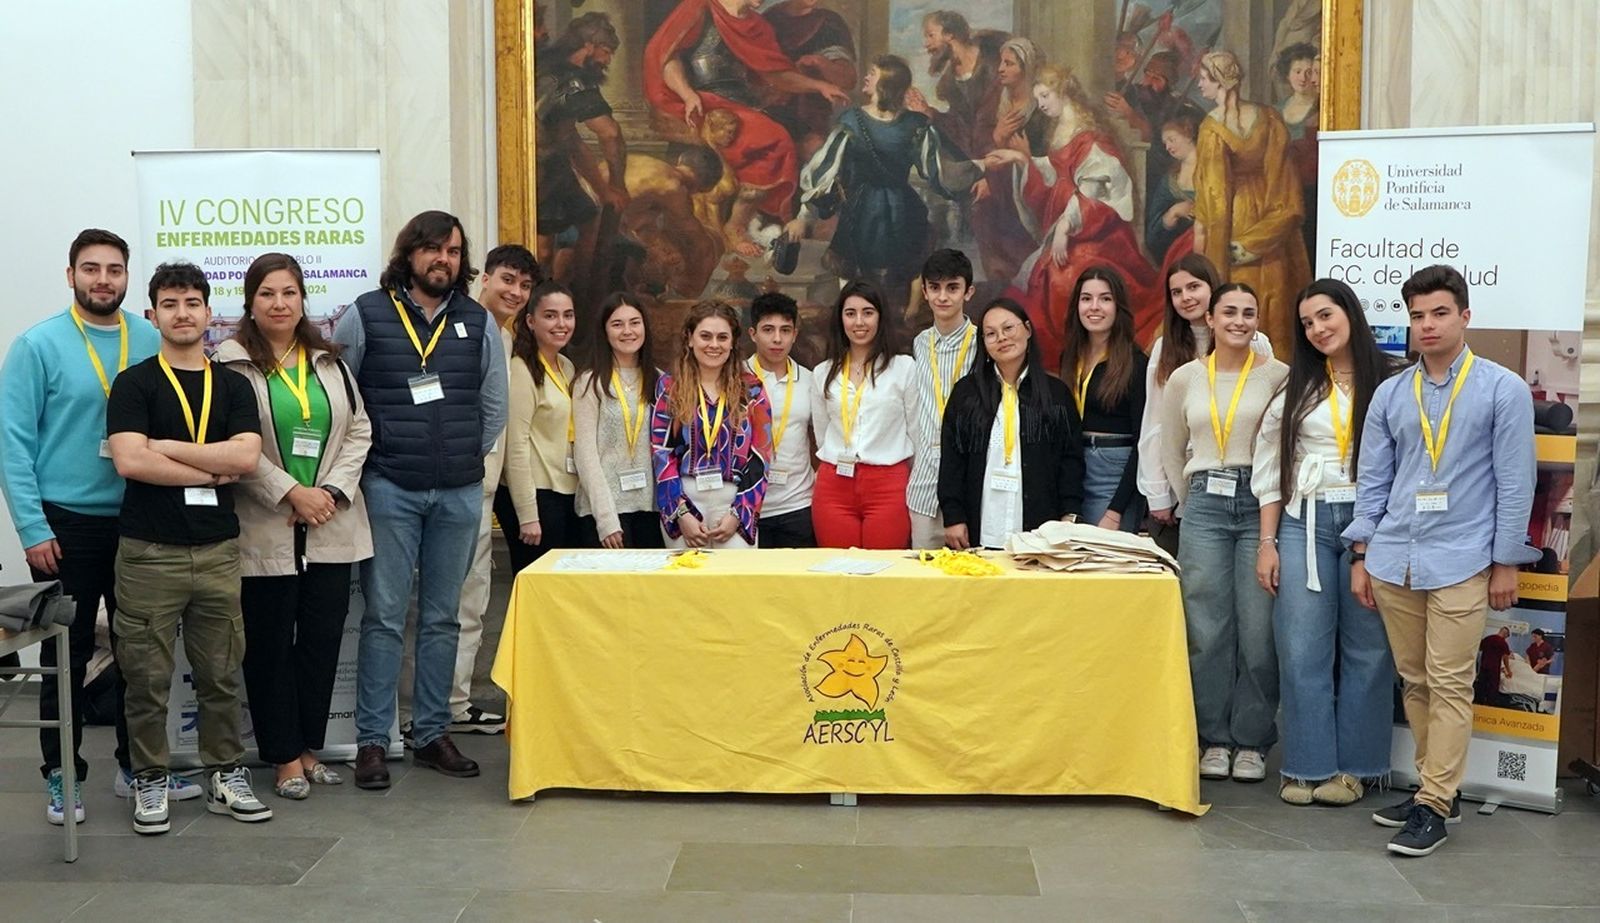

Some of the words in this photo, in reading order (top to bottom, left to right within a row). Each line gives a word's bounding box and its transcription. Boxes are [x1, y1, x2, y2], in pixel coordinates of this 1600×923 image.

[1387, 163, 1463, 178] Universidad
[1386, 181, 1445, 194] Pontificia
[1384, 197, 1400, 211] de
[1401, 197, 1471, 211] Salamanca
[160, 199, 186, 226] IV
[196, 198, 364, 226] CONGRESO
[156, 230, 300, 248] ENFERMEDADES
[304, 229, 365, 245] RARAS
[1330, 238, 1424, 259] Facultad
[1430, 237, 1460, 258] de
[203, 255, 256, 266] AUDITORIO
[295, 255, 315, 265] BLO
[303, 269, 368, 279] SALAMANCA
[1373, 264, 1402, 285] de
[1464, 265, 1499, 286] lud
[213, 286, 225, 296] 18
[226, 287, 235, 297] y
[234, 286, 245, 295] 19
[306, 284, 327, 295] 024
[1519, 582, 1560, 592] gopedia
[802, 652, 812, 662] de
[809, 622, 860, 650] Enfermedades
[863, 623, 885, 638] Raras
[884, 638, 894, 647] de
[1499, 718, 1545, 732] Avanzada
[803, 721, 894, 744] AERSCYL
